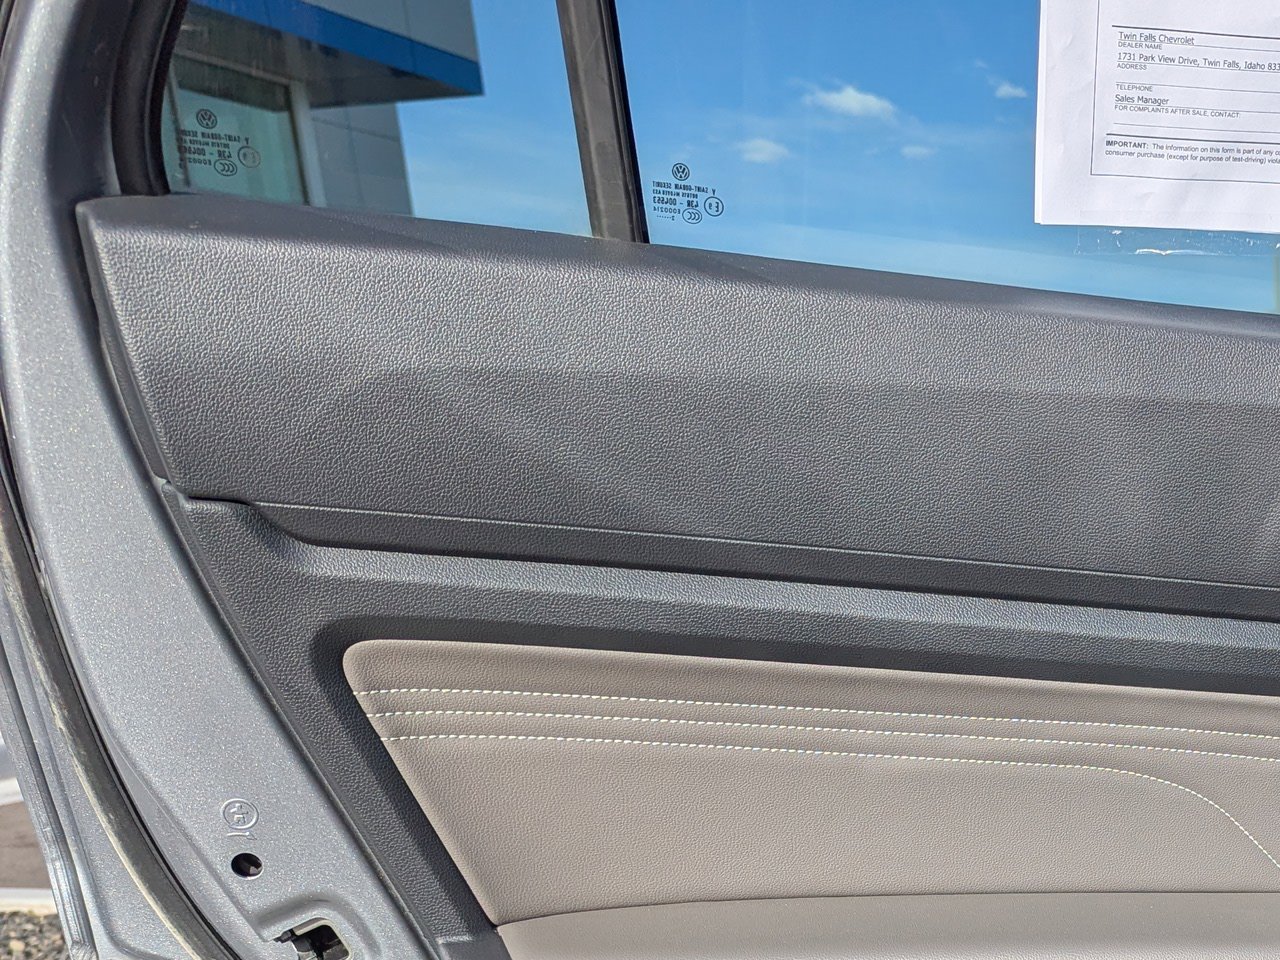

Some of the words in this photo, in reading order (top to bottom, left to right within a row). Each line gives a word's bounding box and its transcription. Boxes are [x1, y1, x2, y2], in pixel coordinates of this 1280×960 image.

[1118, 31, 1137, 41] Twin
[1139, 32, 1157, 43] Falls
[1158, 34, 1195, 45] Chevrolet
[1118, 41, 1143, 49] DEALER
[1117, 52, 1136, 61] 1731
[1138, 53, 1156, 63] Park
[1157, 54, 1176, 64] View
[1178, 56, 1200, 67] Drive,
[1203, 58, 1221, 67] Twin
[1223, 59, 1242, 70] Falls,
[1244, 61, 1266, 70] Idaho
[1117, 63, 1148, 71] ADDRESS
[1116, 83, 1153, 92] TELEPHONE
[1115, 94, 1135, 103] Sales
[1137, 95, 1170, 107] Manager
[1129, 105, 1170, 114] COMPLAINTS
[1170, 108, 1190, 116] AFTER
[1106, 140, 1149, 150] IMPORTANT:
[1152, 143, 1165, 151] The
[1165, 144, 1199, 153] information
[1209, 146, 1221, 154] this
[1242, 148, 1255, 156] part
[1263, 150, 1274, 158] any
[1136, 151, 1165, 160] purchase
[1166, 152, 1189, 161] (except
[1190, 153, 1199, 161] for
[1199, 155, 1224, 163] purpose
[1231, 155, 1267, 165] test-driving)
